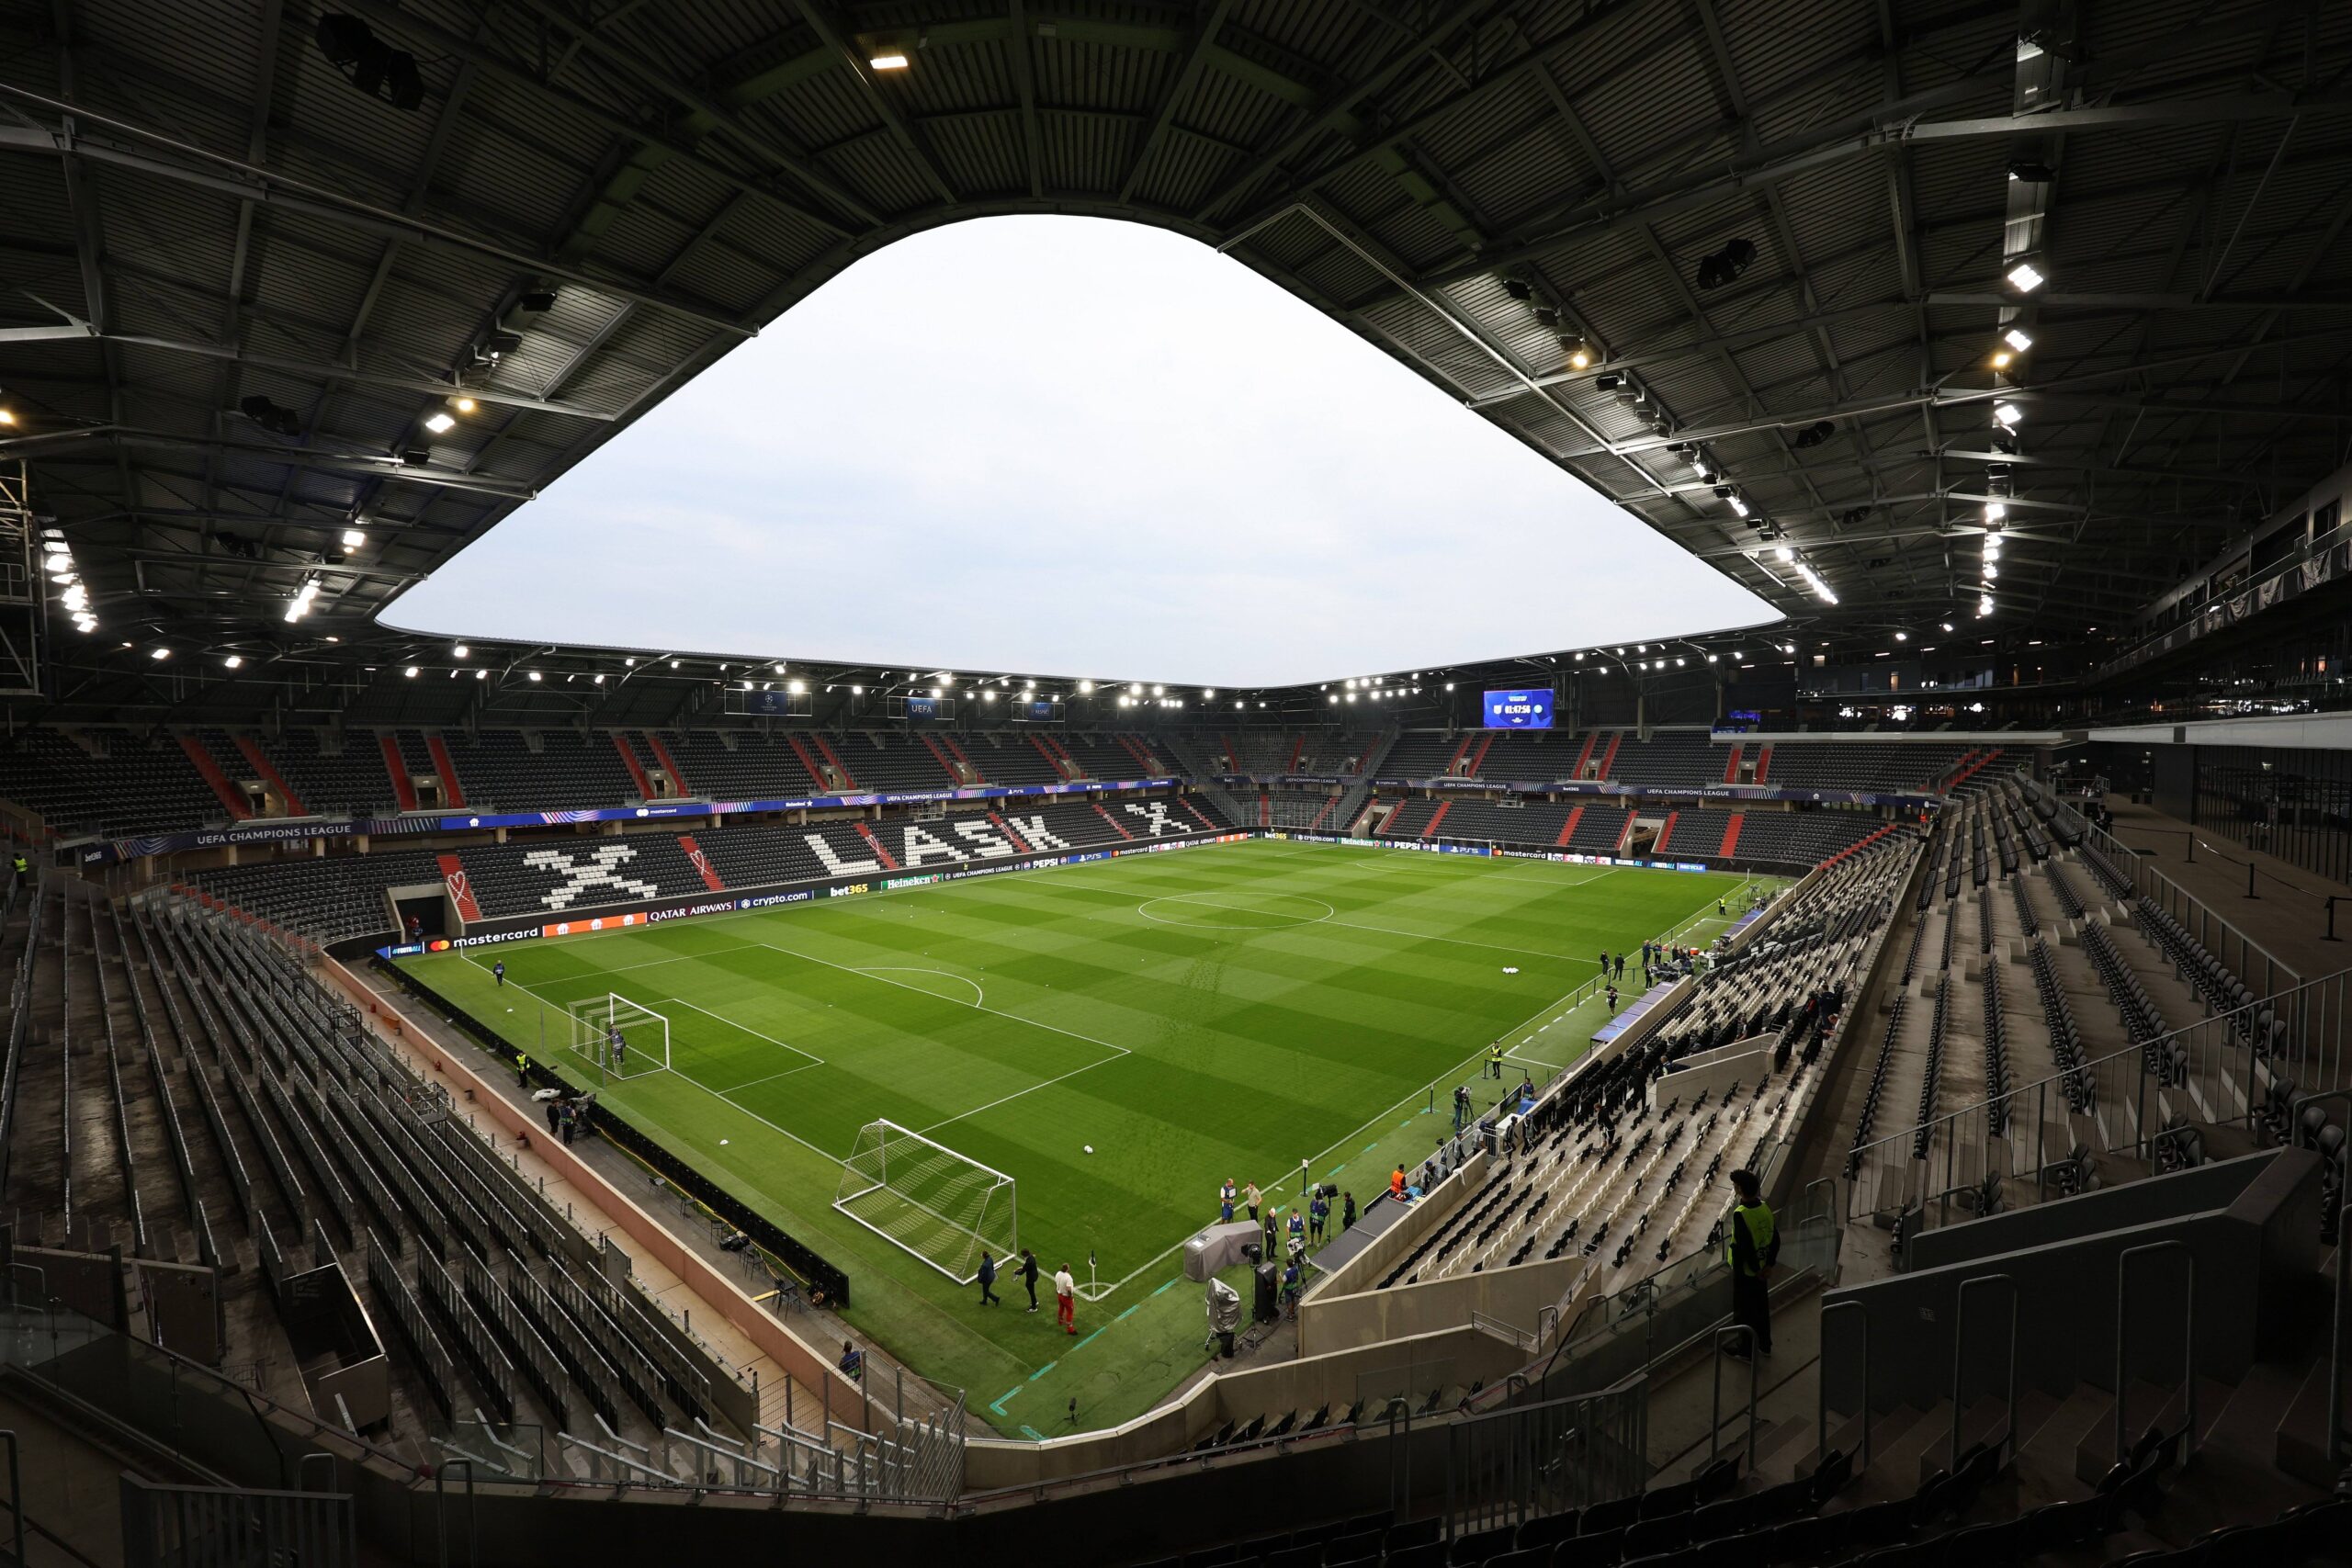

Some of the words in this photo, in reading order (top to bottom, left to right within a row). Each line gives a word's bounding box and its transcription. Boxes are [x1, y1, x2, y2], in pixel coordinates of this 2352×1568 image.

[197, 834, 227, 844] UEFA
[229, 828, 301, 842] CHAMPIONS
[303, 825, 352, 837] LEAGUE
[1264, 831, 1287, 840] bet365
[1303, 834, 1335, 842] crypto.com
[804, 816, 1069, 875] LASK
[1200, 837, 1216, 845] AIRWAYS
[1340, 837, 1374, 847] Heineken
[1394, 841, 1420, 851] PEPSI
[1119, 846, 1148, 856] mastercard
[1503, 850, 1546, 859] mastercard
[1551, 853, 1574, 863] FedEx
[1583, 856, 1607, 864] FedEx
[1033, 858, 1057, 869] PEPSI
[967, 867, 995, 876] CHAMPIONS
[995, 864, 1013, 873] LEAGUE
[887, 876, 931, 890] Heineken
[830, 883, 868, 897] bet365
[752, 891, 808, 908] crypto.com
[650, 908, 686, 922] QATAR
[689, 901, 732, 916] AIRWAYS
[453, 927, 538, 948] mastercard
